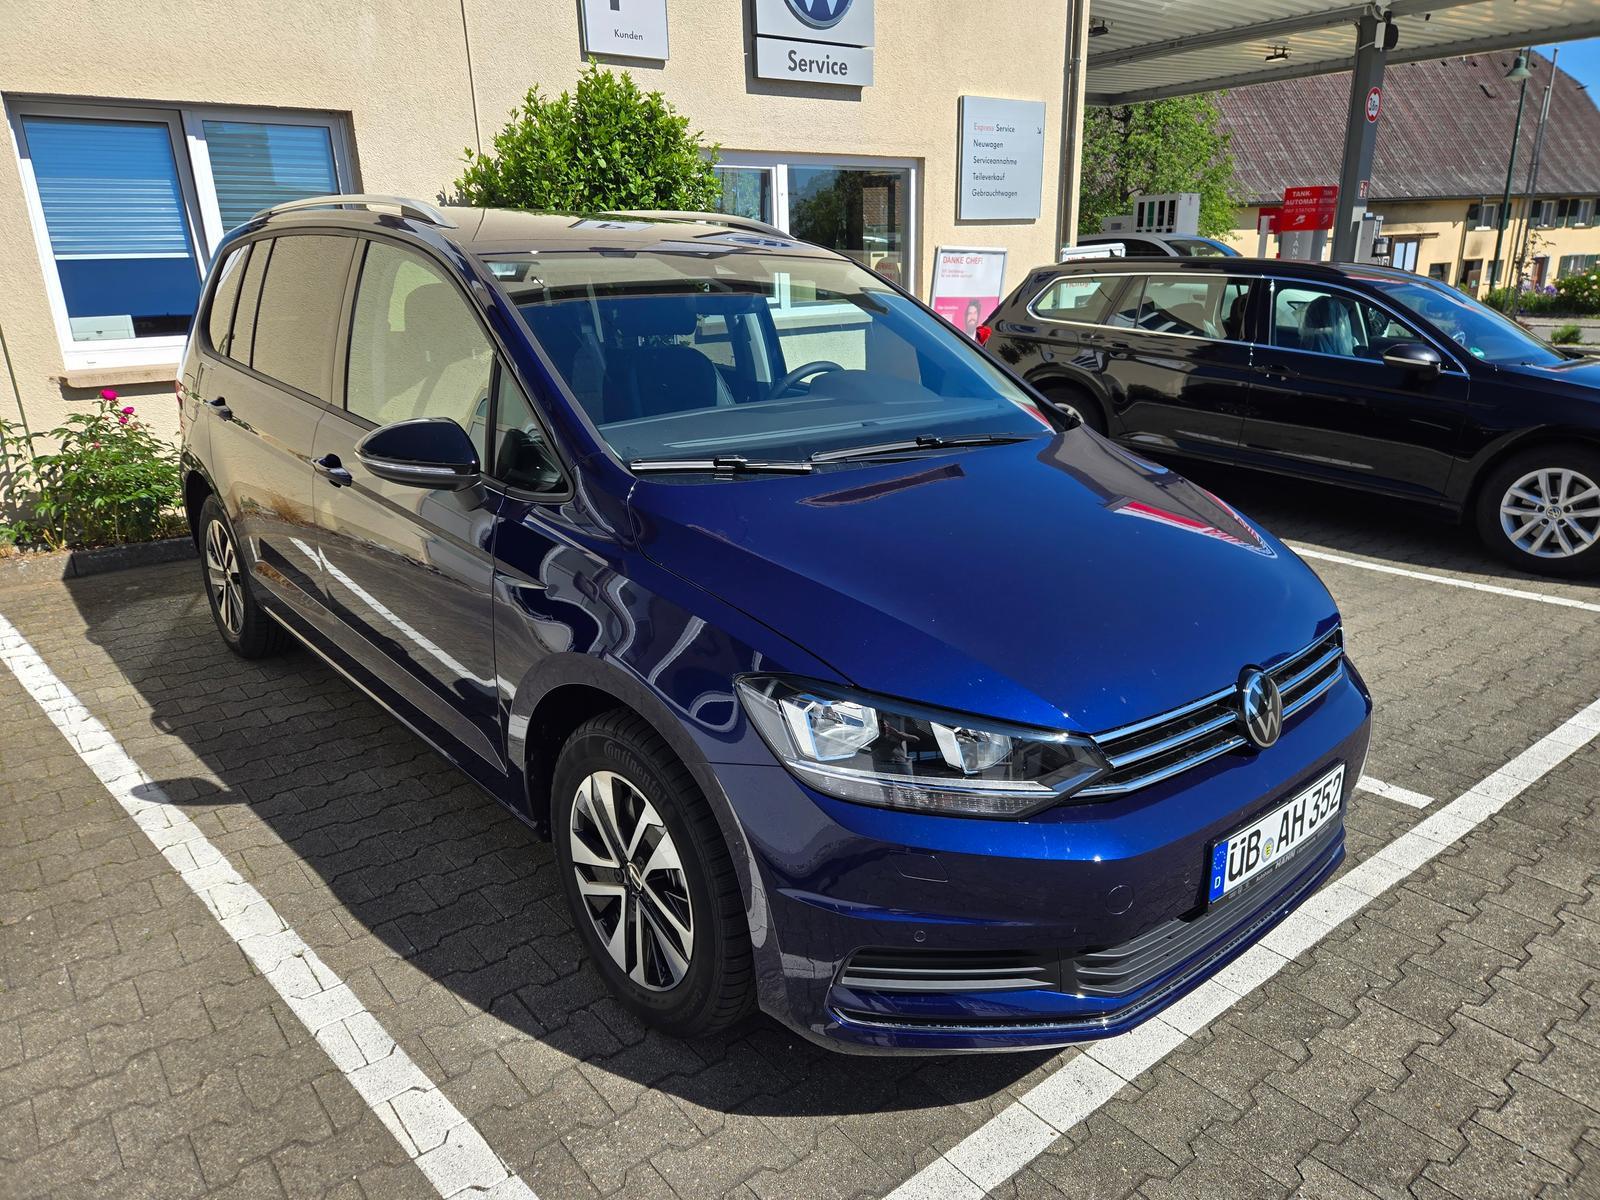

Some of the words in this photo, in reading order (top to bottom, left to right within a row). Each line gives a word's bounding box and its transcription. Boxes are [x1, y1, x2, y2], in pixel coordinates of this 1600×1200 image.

[613, 28, 644, 41] Kunden
[787, 49, 848, 76] Service
[995, 124, 1016, 133] Service
[973, 139, 1004, 149] Neuwagen
[973, 155, 1018, 166] Serviceannahme
[972, 172, 1006, 182] Teileverkauf
[971, 188, 1018, 198] Gebrauchtwagen
[942, 256, 964, 264] DANKE
[1228, 829, 1261, 882] ÜB
[1275, 799, 1306, 853] AH
[1308, 772, 1342, 829] 352
[1214, 876, 1221, 889] D
